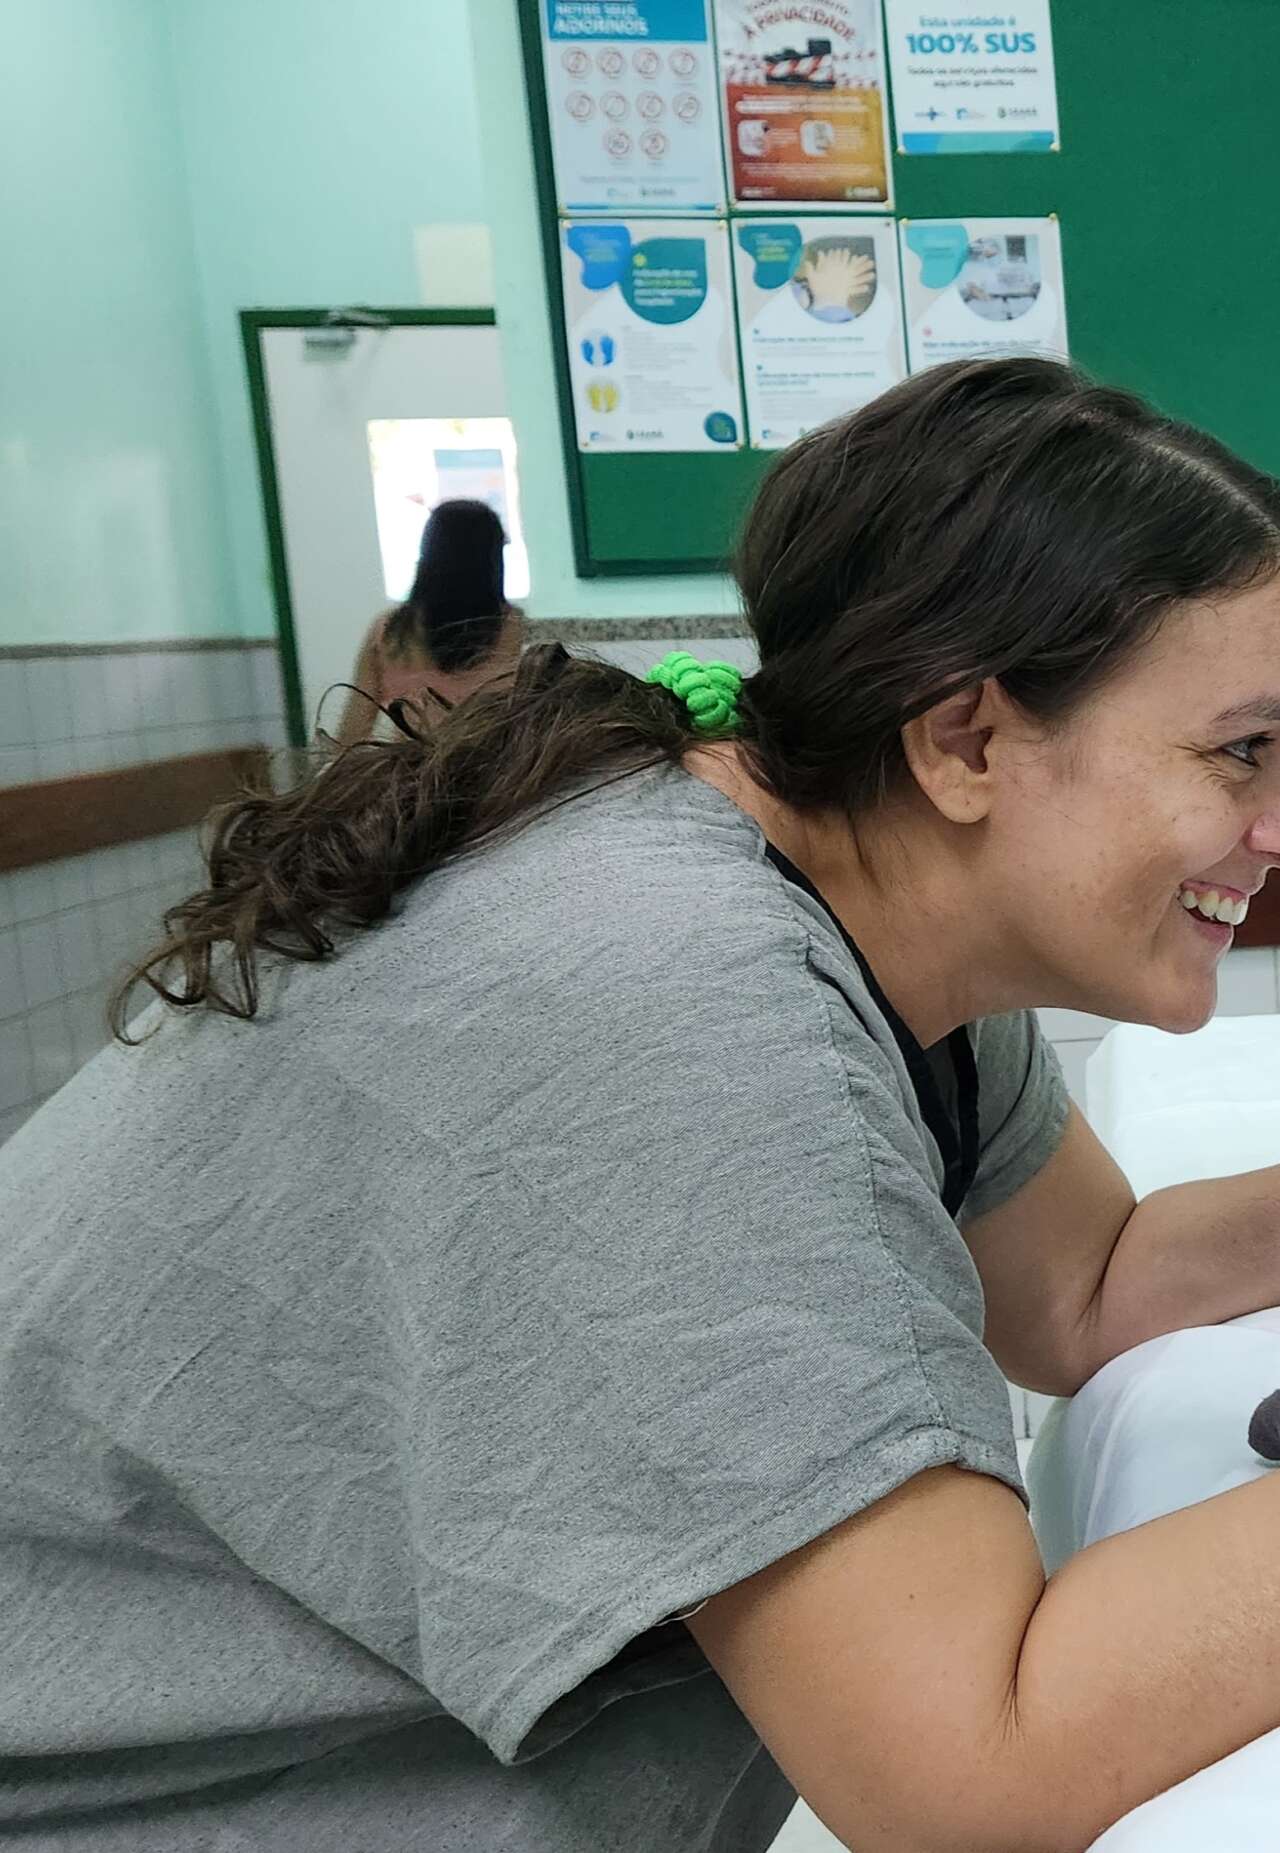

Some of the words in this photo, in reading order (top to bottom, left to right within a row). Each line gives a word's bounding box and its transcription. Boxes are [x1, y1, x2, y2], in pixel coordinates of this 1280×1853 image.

[555, 16, 649, 34] ADORNOS
[754, 6, 856, 41] PRIVACIDADE
[906, 33, 979, 53] 100%
[985, 32, 1037, 53] SUS
